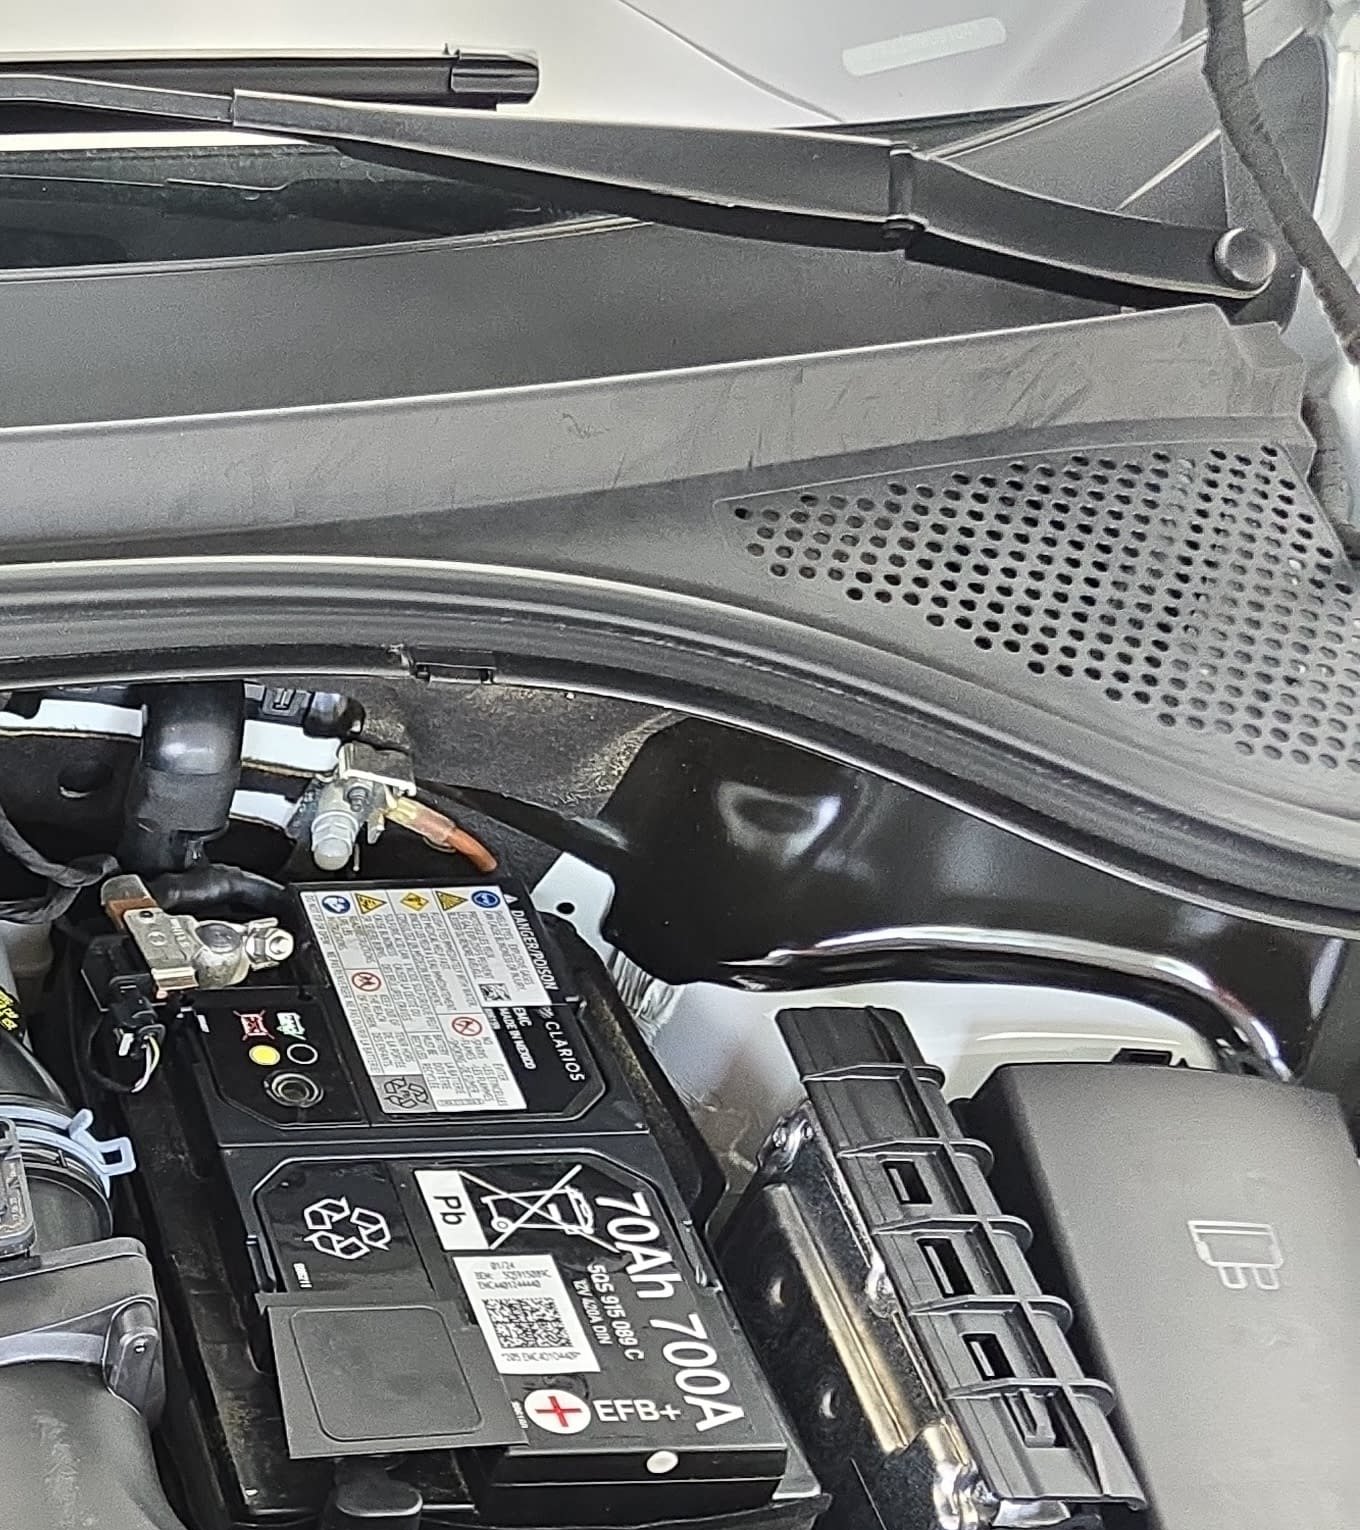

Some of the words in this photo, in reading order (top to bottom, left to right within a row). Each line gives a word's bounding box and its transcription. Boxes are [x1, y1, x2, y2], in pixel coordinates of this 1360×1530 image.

[510, 909, 560, 991] DANGER/POISON
[498, 1008, 517, 1029] MADE
[508, 1030, 523, 1038] IN
[513, 1007, 533, 1026] EMC
[543, 1021, 585, 1080] CLARIOS
[433, 1194, 468, 1226] Pb
[570, 1279, 593, 1297] 12V
[578, 1299, 605, 1323] 420A
[594, 1191, 683, 1300] 70Ah
[649, 1314, 745, 1432] 700A
[598, 1295, 627, 1317] 915
[591, 1326, 614, 1344] DIN
[609, 1322, 638, 1344] 089
[622, 1348, 646, 1359] C
[593, 1399, 681, 1423] EFB+
